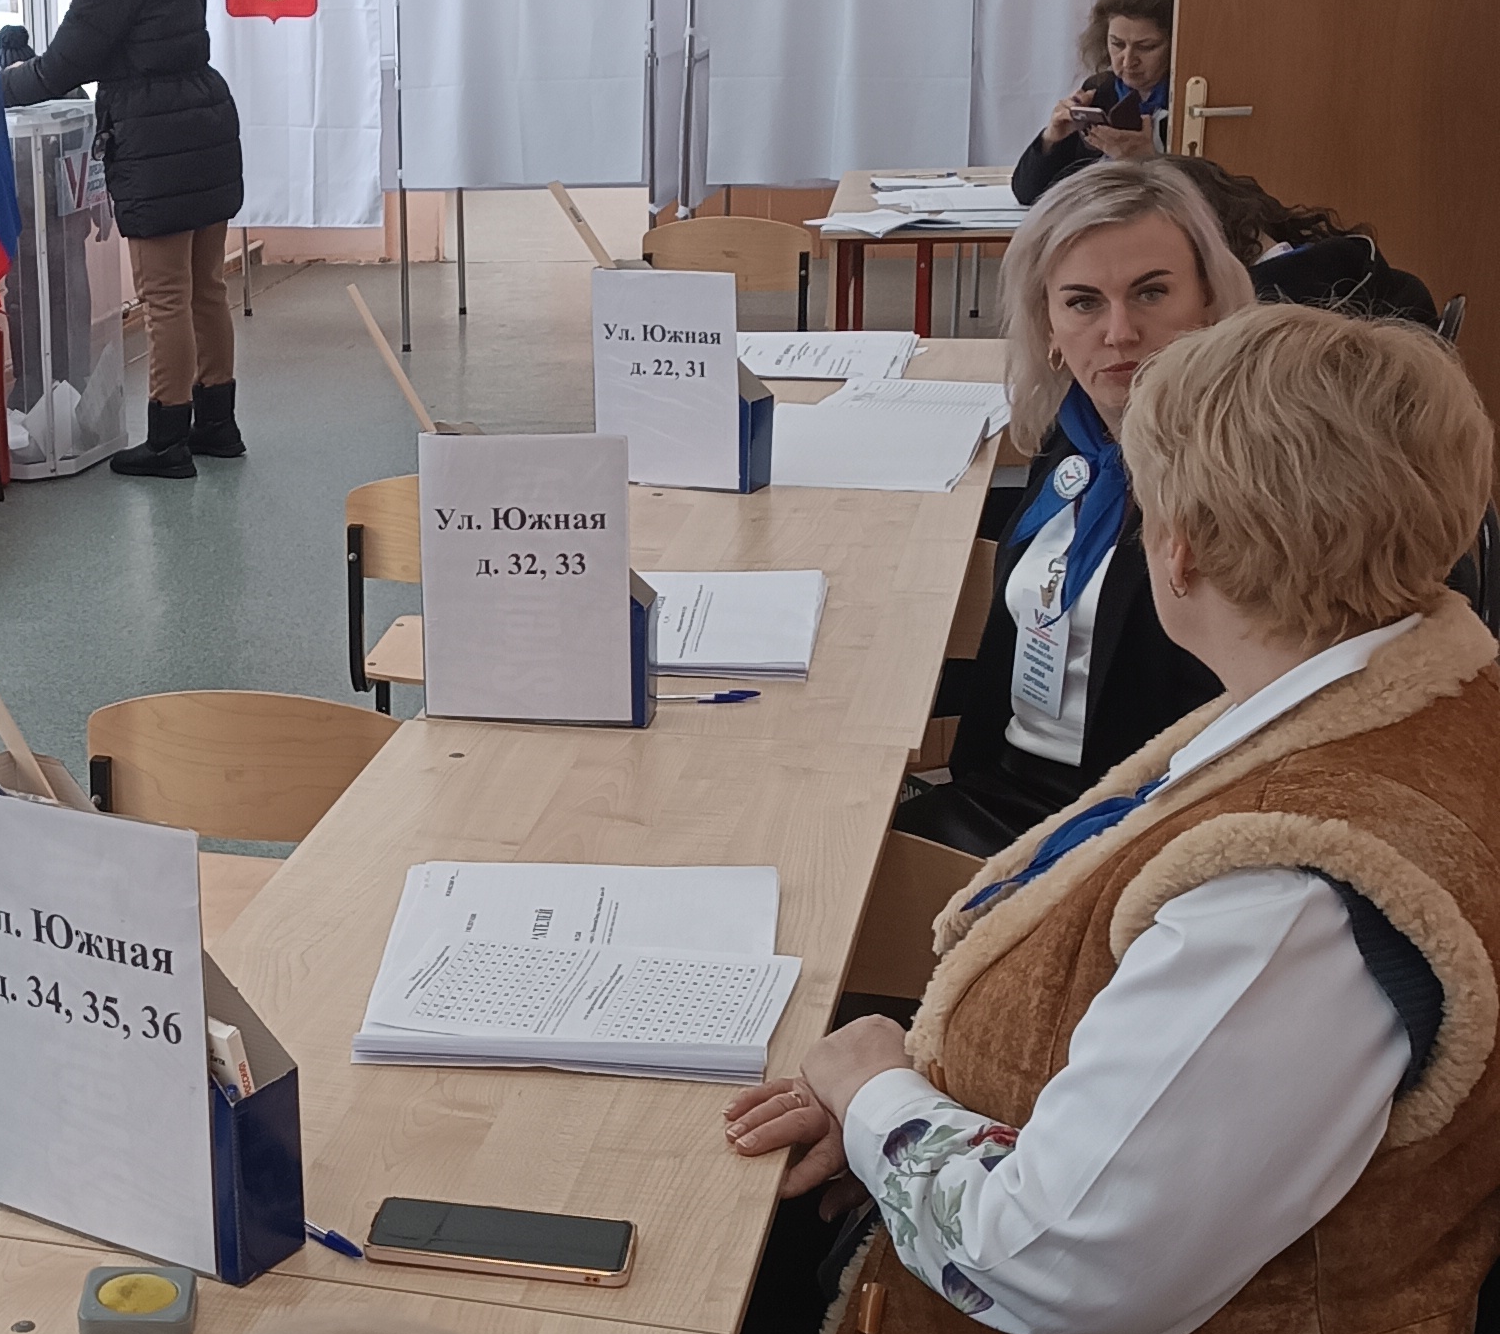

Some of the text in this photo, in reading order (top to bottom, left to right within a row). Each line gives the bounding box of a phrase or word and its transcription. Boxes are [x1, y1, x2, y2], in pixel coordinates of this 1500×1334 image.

[603, 323, 721, 345] Ул. Южная
[630, 358, 707, 379] д. 22, 31
[434, 506, 606, 531] Ул. Южная
[475, 552, 586, 580] д. 32, 33
[531, 908, 554, 941] АТЕЛЕЙ
[30, 908, 174, 976] Южная
[27, 975, 73, 1024] 34,
[82, 990, 131, 1040] 35,
[141, 1005, 182, 1045] 36
